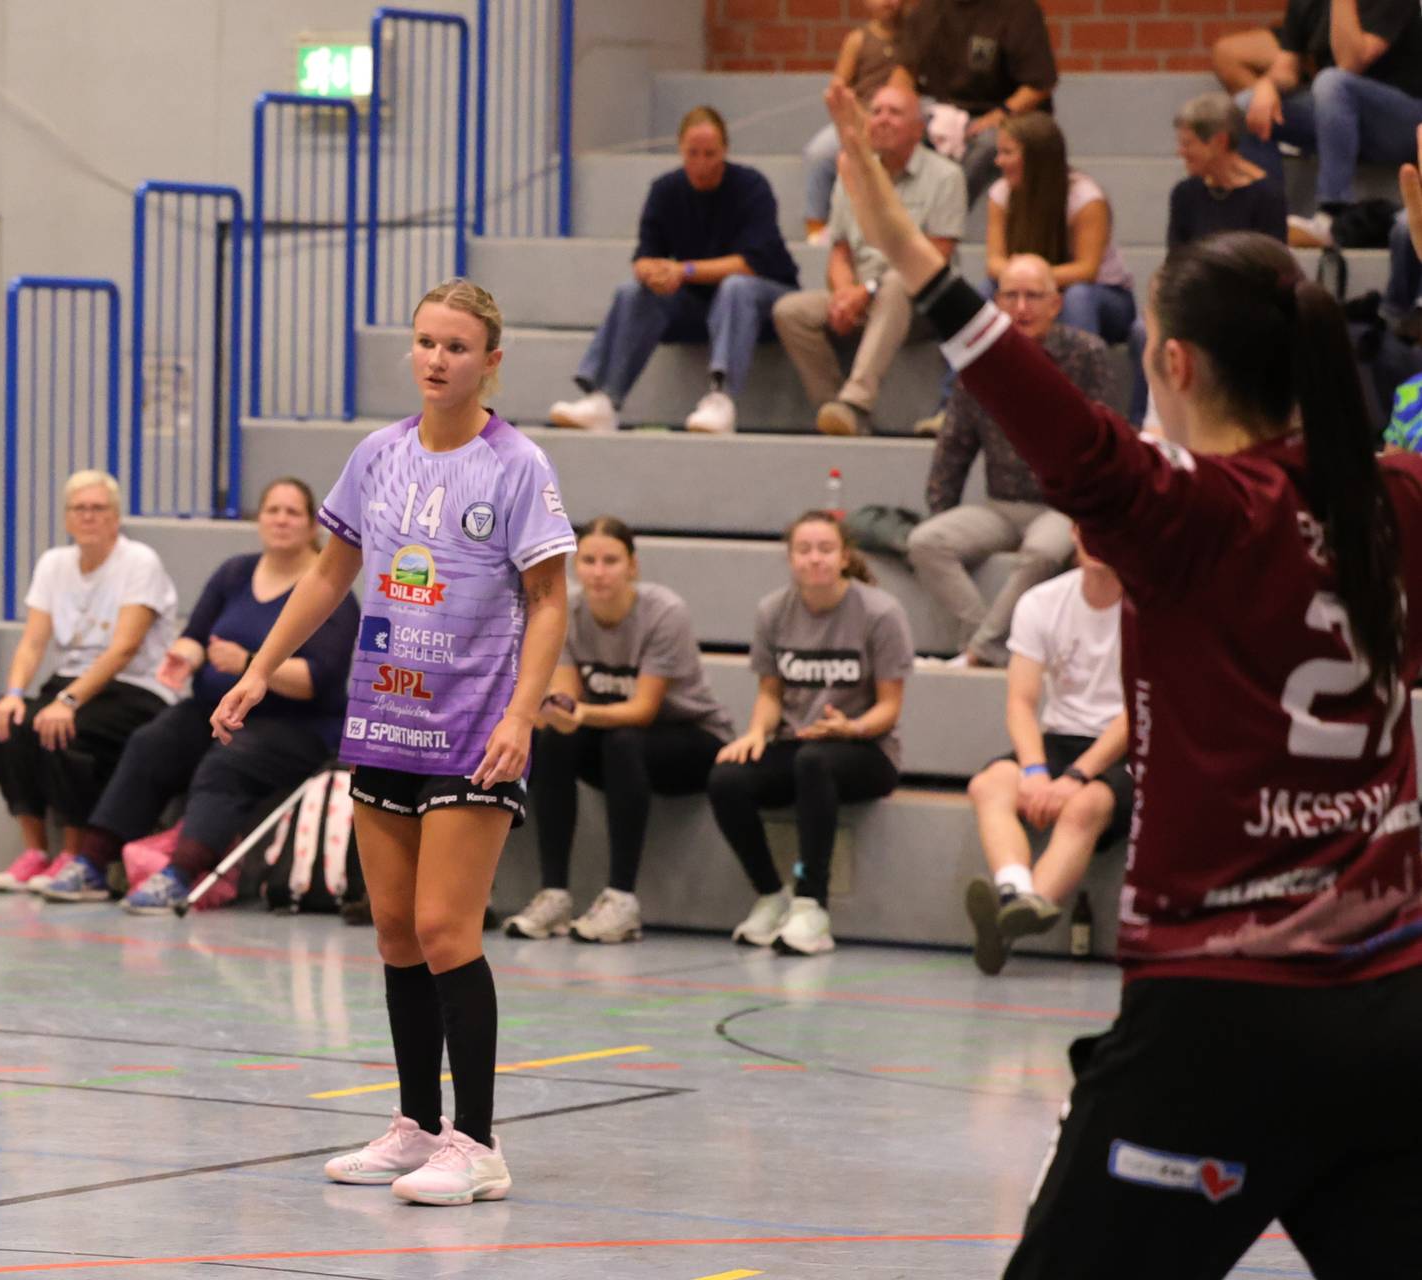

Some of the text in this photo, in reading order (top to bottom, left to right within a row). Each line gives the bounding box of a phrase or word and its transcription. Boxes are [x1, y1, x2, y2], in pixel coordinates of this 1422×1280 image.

[399, 482, 446, 539] 14
[394, 625, 456, 648] ECKERT
[393, 642, 454, 665] SCHULEN
[371, 663, 433, 700] SIPL
[367, 722, 451, 749] SPORTHARTL
[466, 792, 498, 804] Kempa
